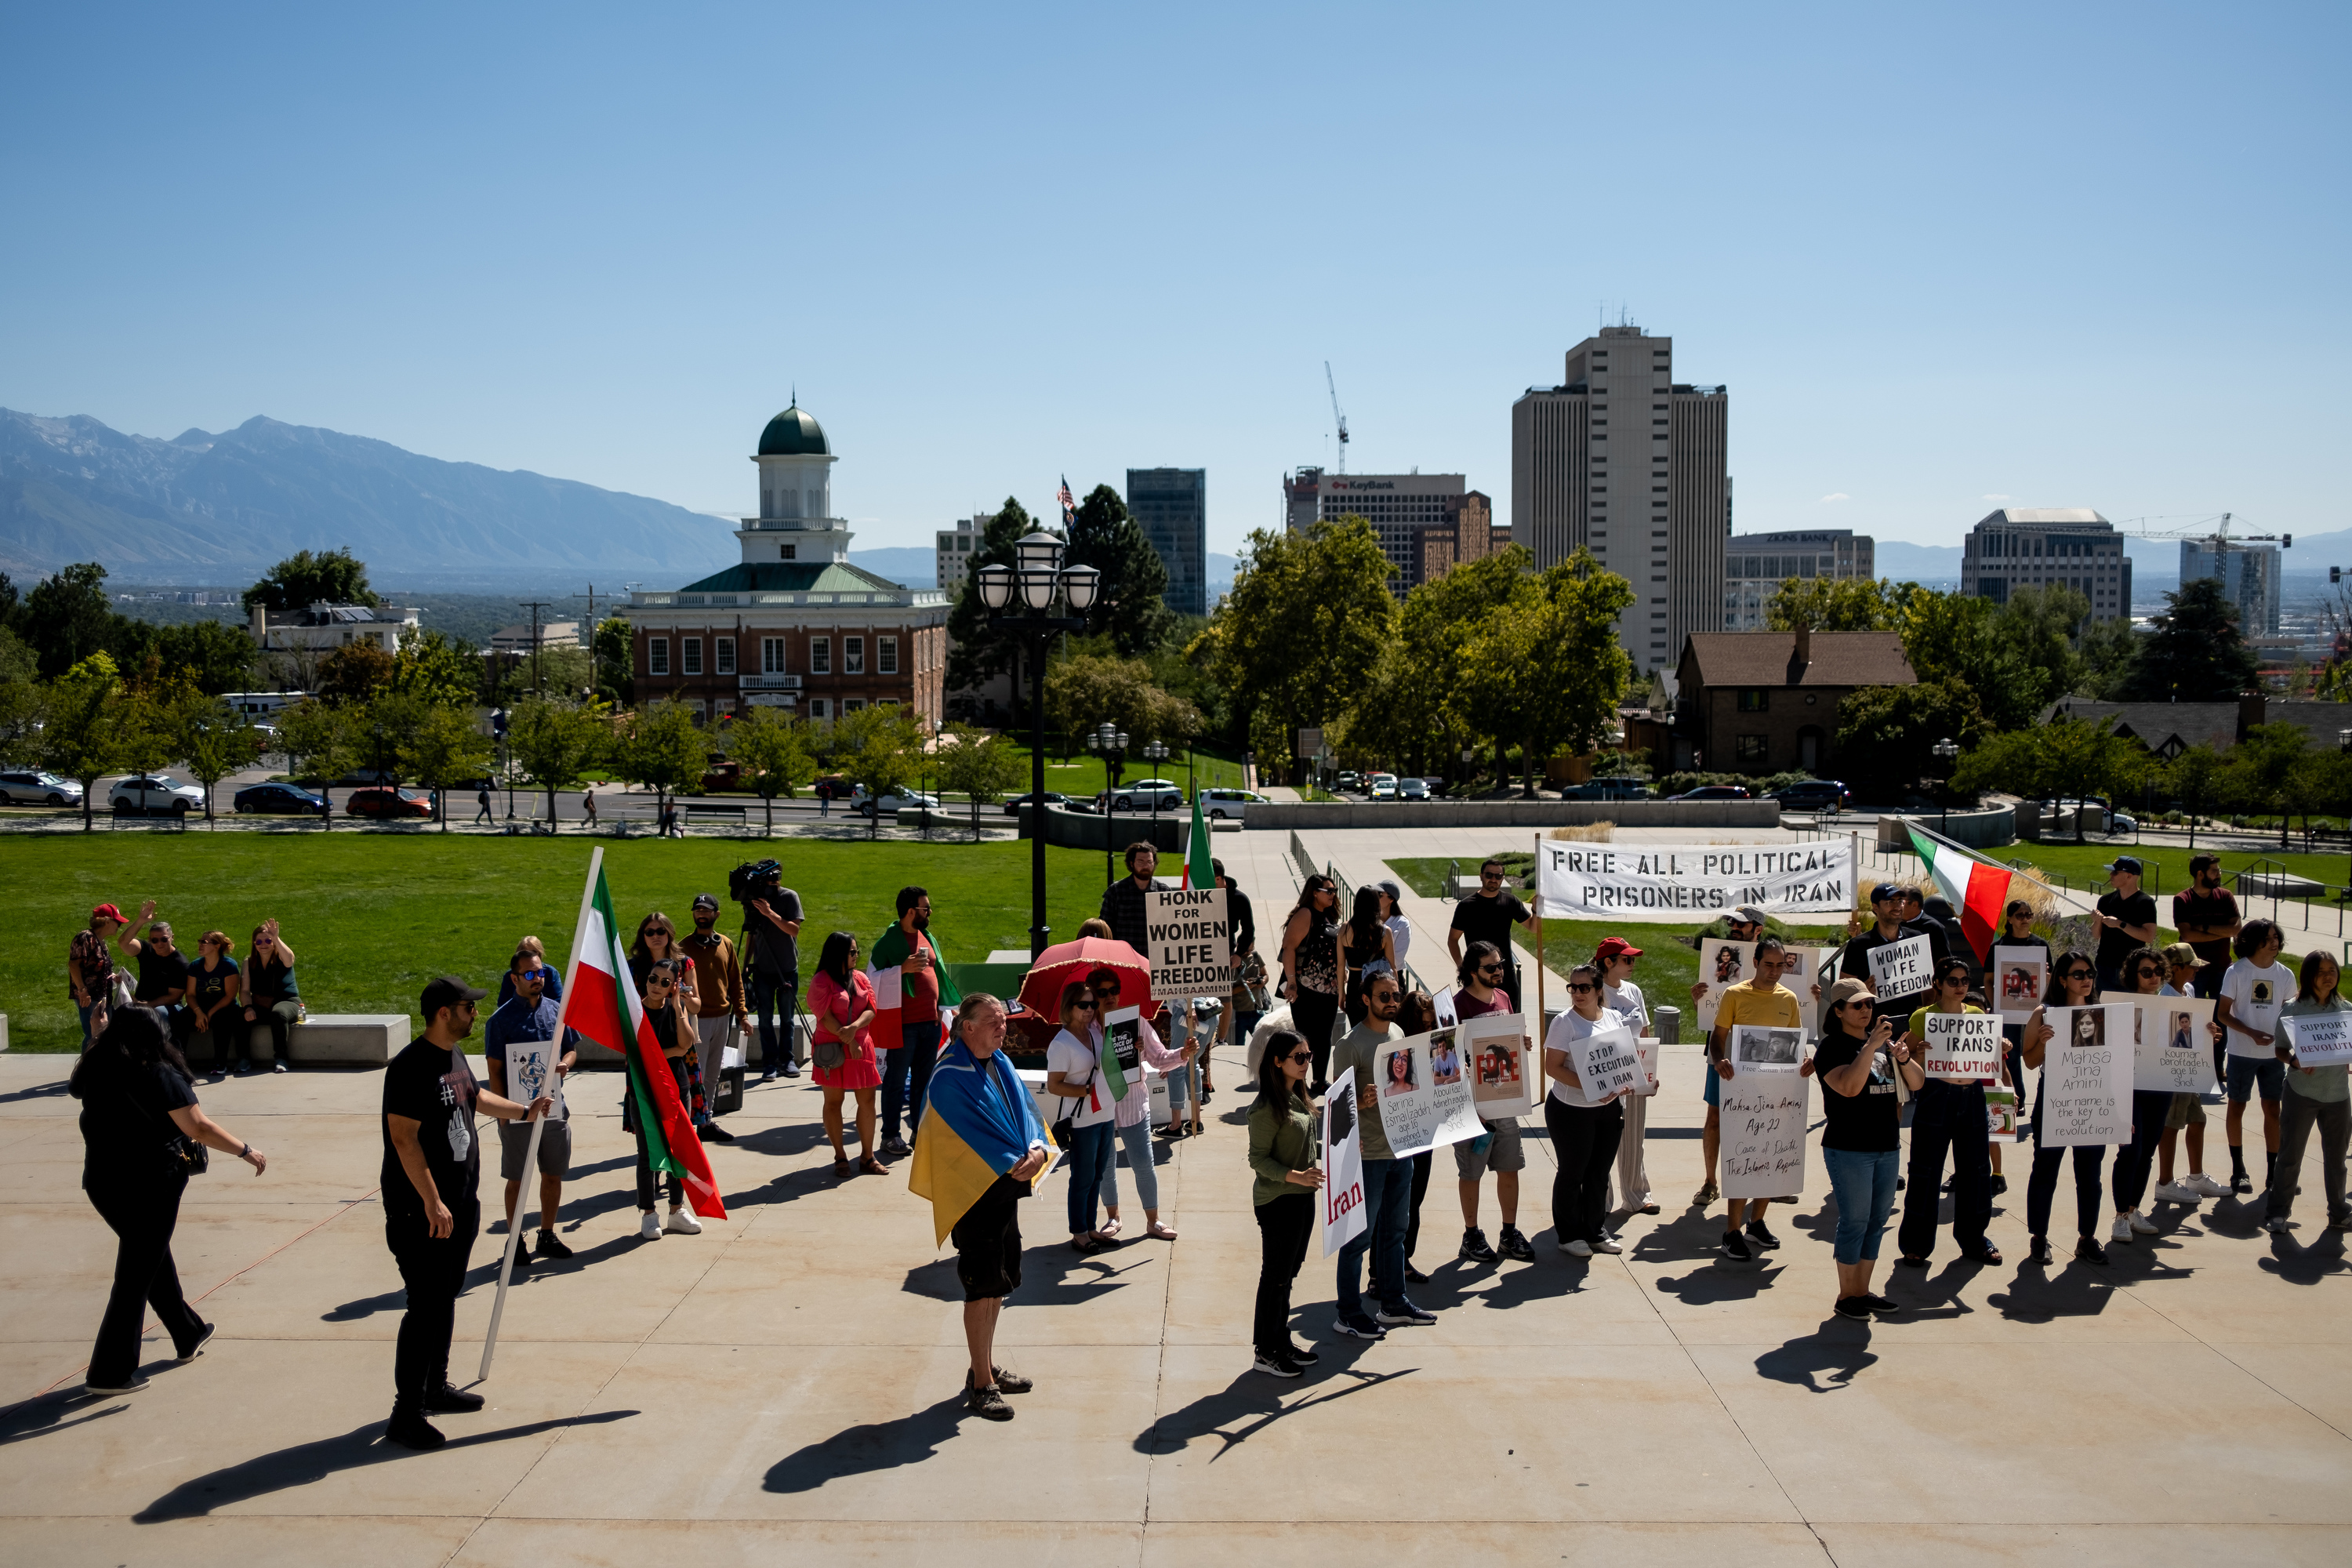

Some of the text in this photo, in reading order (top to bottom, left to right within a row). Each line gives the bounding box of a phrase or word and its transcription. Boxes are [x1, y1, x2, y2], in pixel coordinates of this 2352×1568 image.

[1349, 481, 1395, 491] KeyBank
[1552, 850, 1835, 876] FREE ALL POLITICAL
[1160, 890, 1213, 906] HONK
[1583, 880, 1842, 909] PRISONERS IN IRAN
[1174, 909, 1200, 919] FOR
[1149, 920, 1227, 942] WOMEN
[1164, 944, 1214, 965] LIFE
[1875, 942, 1920, 966] WOMAN
[1151, 965, 1230, 985] FREEDOM
[1882, 959, 1917, 979] LIFE
[1151, 985, 1230, 996] #MAHSAAMINI
[1877, 973, 1932, 998] FREEDOM
[1928, 1018, 1995, 1035] SUPPORT
[2300, 1021, 2348, 1032] SUPPORT
[2312, 1031, 2347, 1041] IRAN'S
[1115, 1044, 1134, 1053] ANIANS
[1947, 1036, 1994, 1053] IRAN'S
[1588, 1045, 1613, 1061] STOP
[2061, 1049, 2112, 1066] Mahsa
[2165, 1049, 2201, 1058] Koumar
[1588, 1054, 1636, 1076] EXECUTION
[1928, 1060, 2000, 1073] REVOLUTION
[2072, 1065, 2101, 1079] Jina
[2170, 1067, 2187, 1079] age
[1596, 1080, 1607, 1091] IN
[1613, 1071, 1634, 1087] IRAN
[2062, 1077, 2103, 1091] Amini
[1433, 1083, 1464, 1098] Aboulfazl
[1388, 1097, 1414, 1115] Sarina
[1722, 1098, 1751, 1112] Mahsa
[1754, 1095, 1774, 1113] Jina
[2050, 1098, 2115, 1109] Your name is
[2058, 1106, 2109, 1120] the key to
[1398, 1119, 1419, 1135] age 16
[1746, 1118, 1780, 1135] Age 22
[2056, 1123, 2114, 1136] revolution
[2071, 1118, 2086, 1127] our
[1406, 1138, 1425, 1149] death
[1762, 1141, 1769, 1155] of
[1773, 1138, 1798, 1156] Death
[1726, 1158, 1741, 1176] The
[1741, 1158, 1769, 1176] Islamic
